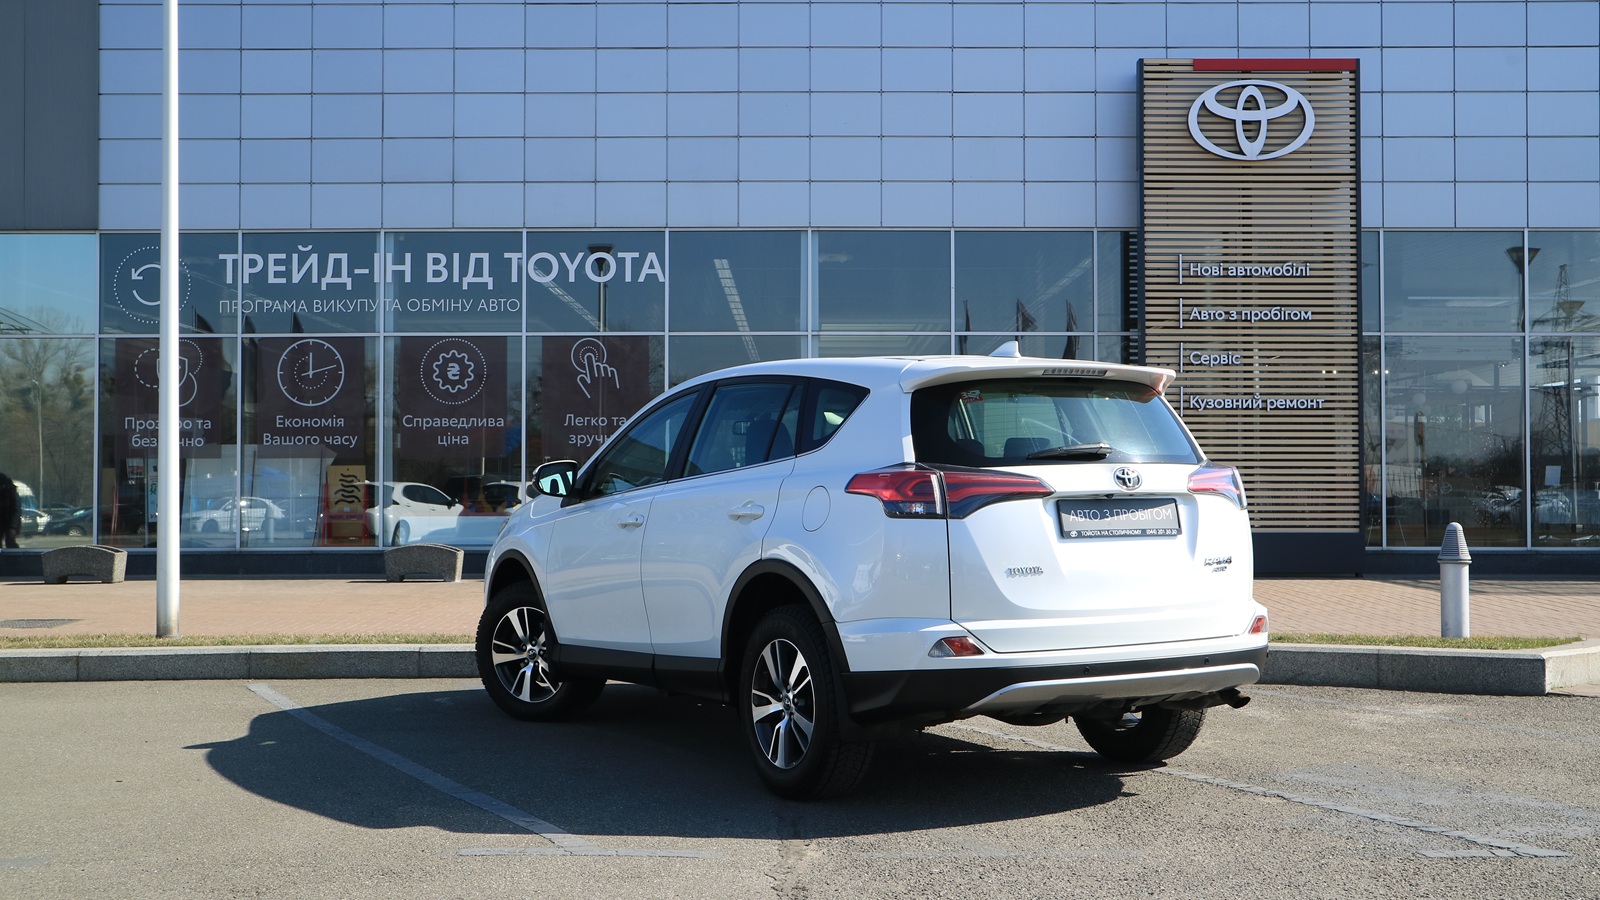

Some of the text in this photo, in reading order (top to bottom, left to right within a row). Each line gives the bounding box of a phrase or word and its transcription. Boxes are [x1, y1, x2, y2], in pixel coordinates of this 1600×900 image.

[219, 245, 666, 290] ТРЕЙД-ІН ВІД TOYOTA
[1189, 263, 1310, 276] Нові автомобілі
[219, 298, 521, 313] ПРОГРАМА ВИКУПУ ТА ОБМІНУ АВТО
[1189, 306, 1312, 323] Авто з пробігом
[1189, 351, 1242, 367] Сервіс
[1189, 395, 1325, 411] Кузовний ремонт
[196, 419, 212, 429] та
[275, 415, 344, 428] Економія
[402, 415, 505, 429] Справедлива
[564, 413, 627, 427] Легко та
[132, 434, 204, 447] безчно
[263, 434, 358, 448] Вашого часу
[437, 433, 469, 446] ціна
[1069, 509, 1101, 522] АВТО
[1113, 508, 1173, 521] ПРОБІГОМ
